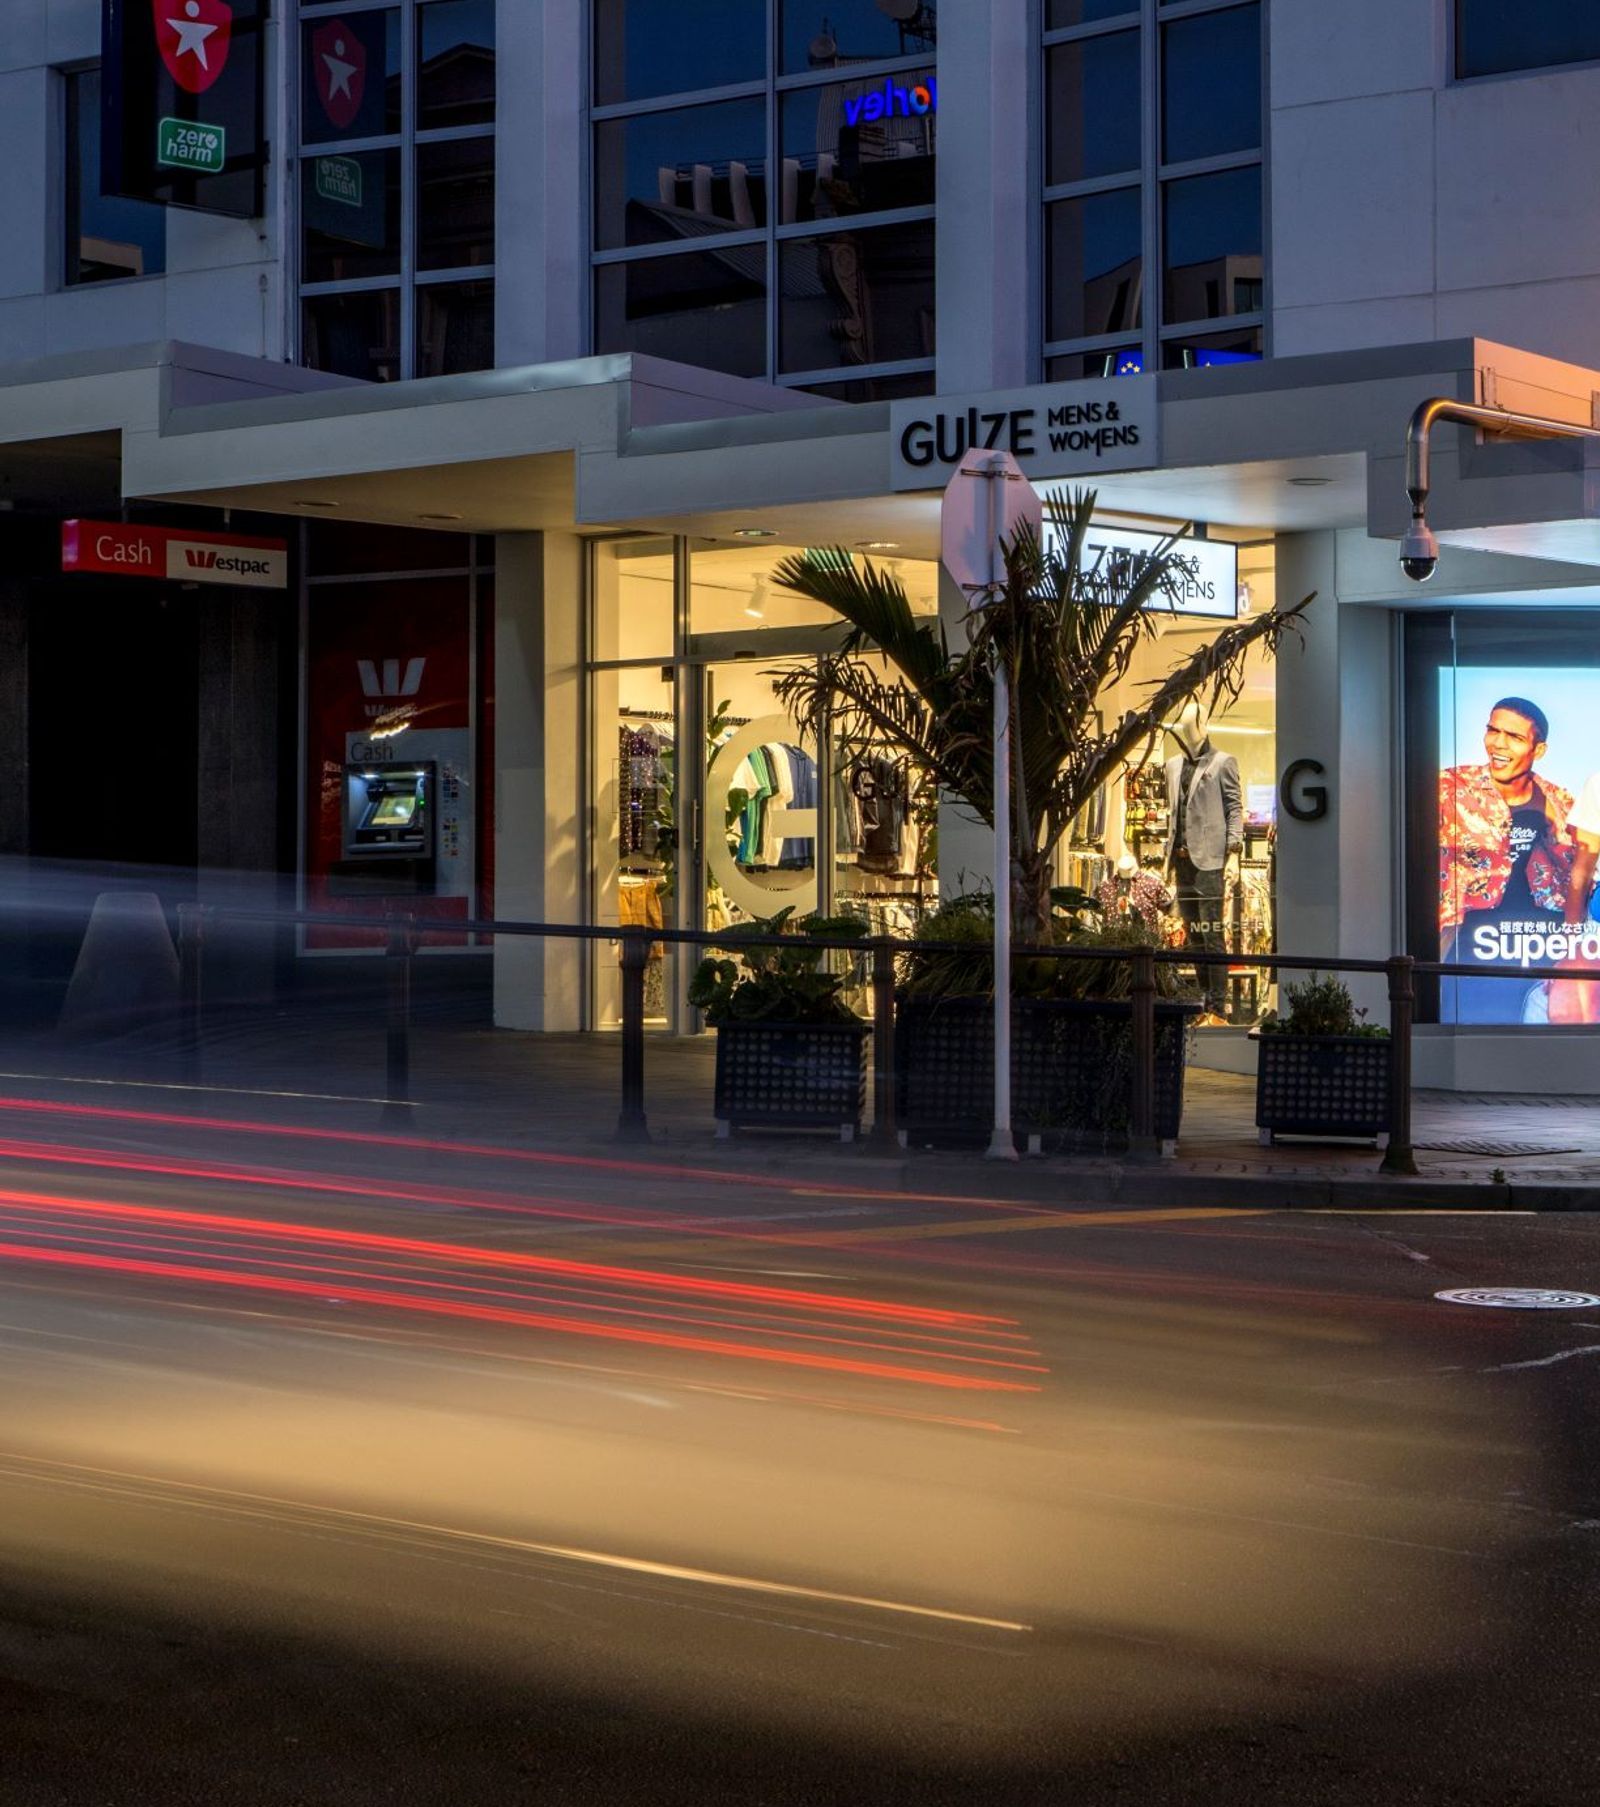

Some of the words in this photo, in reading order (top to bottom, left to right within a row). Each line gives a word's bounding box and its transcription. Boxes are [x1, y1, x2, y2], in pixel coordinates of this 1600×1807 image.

[166, 137, 212, 163] harm
[1048, 402, 1102, 428] MENS
[1106, 401, 1120, 422] &
[901, 407, 1036, 467] GUIZE
[1048, 425, 1140, 457] WOMENS
[96, 536, 152, 565] Cash
[185, 549, 270, 576] Westpac
[351, 741, 393, 762] Cash
[1280, 758, 1327, 822] G
[1190, 921, 1210, 933] NO
